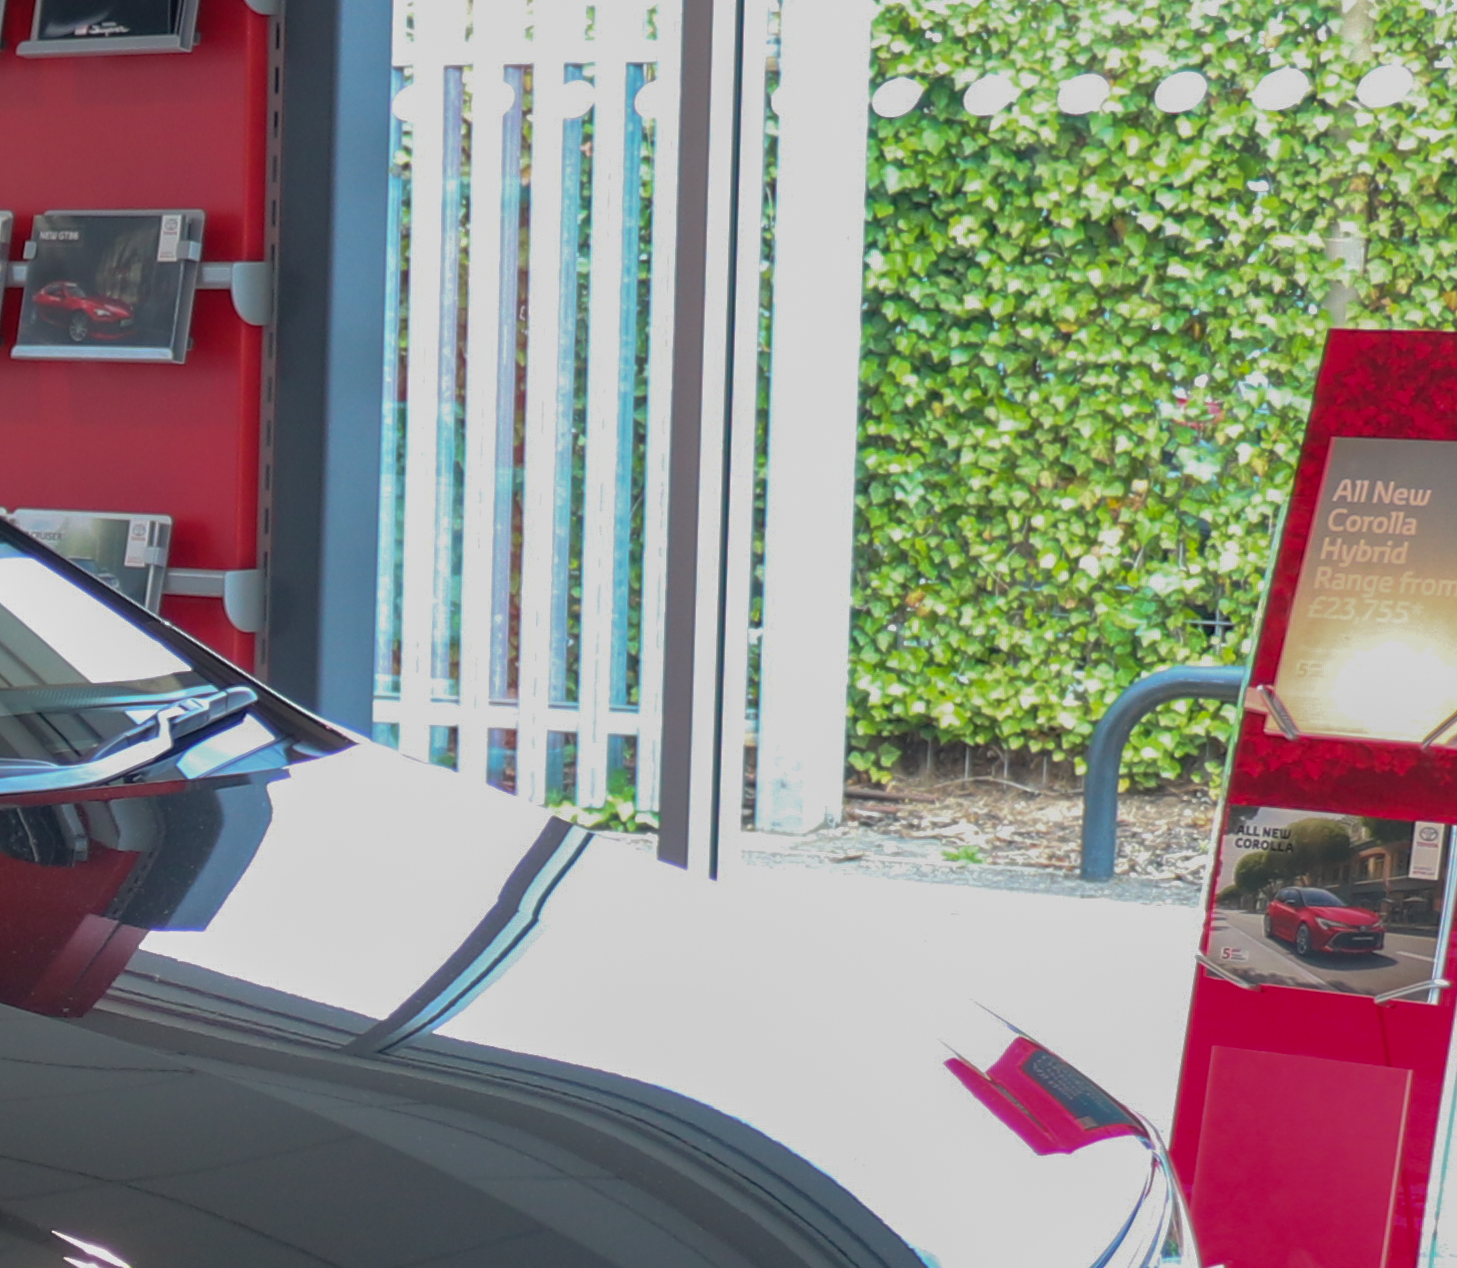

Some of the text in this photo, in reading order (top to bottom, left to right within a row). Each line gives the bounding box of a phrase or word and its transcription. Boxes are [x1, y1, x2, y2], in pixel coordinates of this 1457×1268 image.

[1332, 478, 1433, 507] All New
[1327, 507, 1418, 536] Corolla
[1319, 536, 1410, 568] Hybrid
[1313, 566, 1394, 598] Range
[1235, 838, 1294, 852] COROLLA
[1236, 825, 1292, 839] ALL NEW
